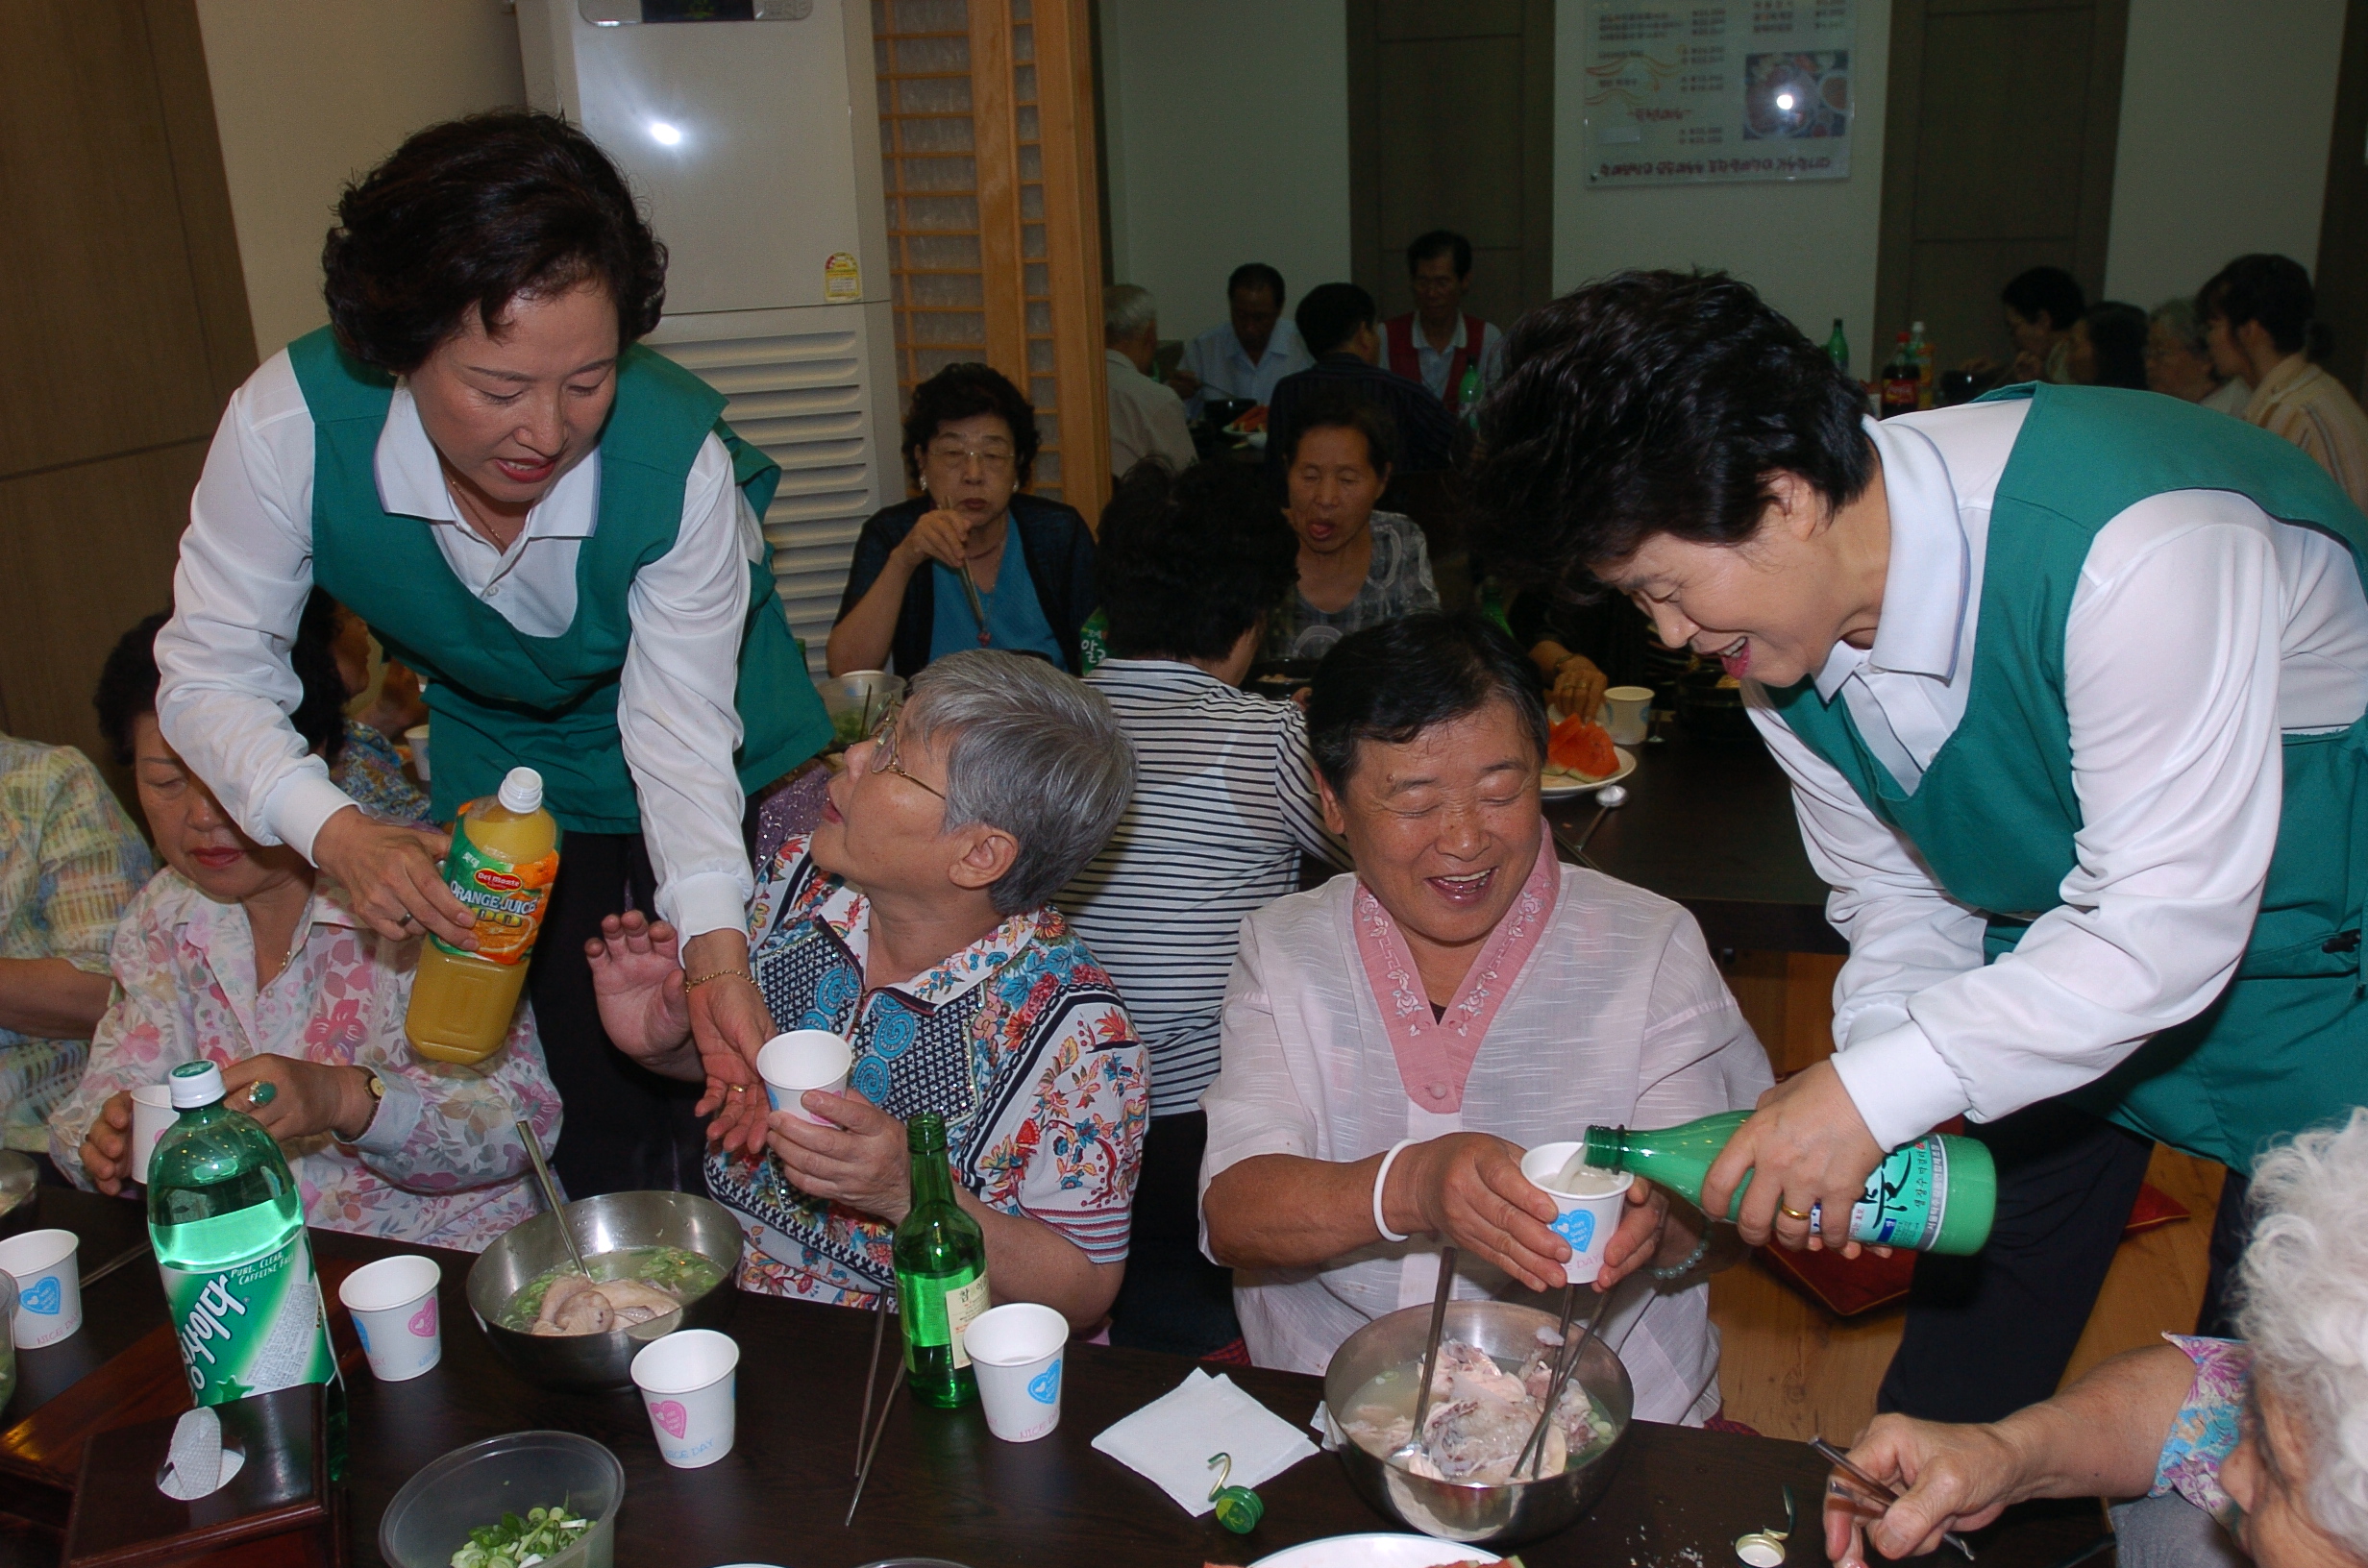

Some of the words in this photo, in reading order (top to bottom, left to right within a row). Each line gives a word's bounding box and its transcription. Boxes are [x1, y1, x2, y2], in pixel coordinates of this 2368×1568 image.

[478, 872, 491, 881] Del
[492, 875, 519, 887] Monte
[450, 880, 500, 909] ORANGE
[501, 898, 539, 915] JUICE
[238, 1265, 277, 1286] CAFFEINE
[1020, 1423, 1046, 1439] NICE
[691, 1438, 715, 1457] DAY
